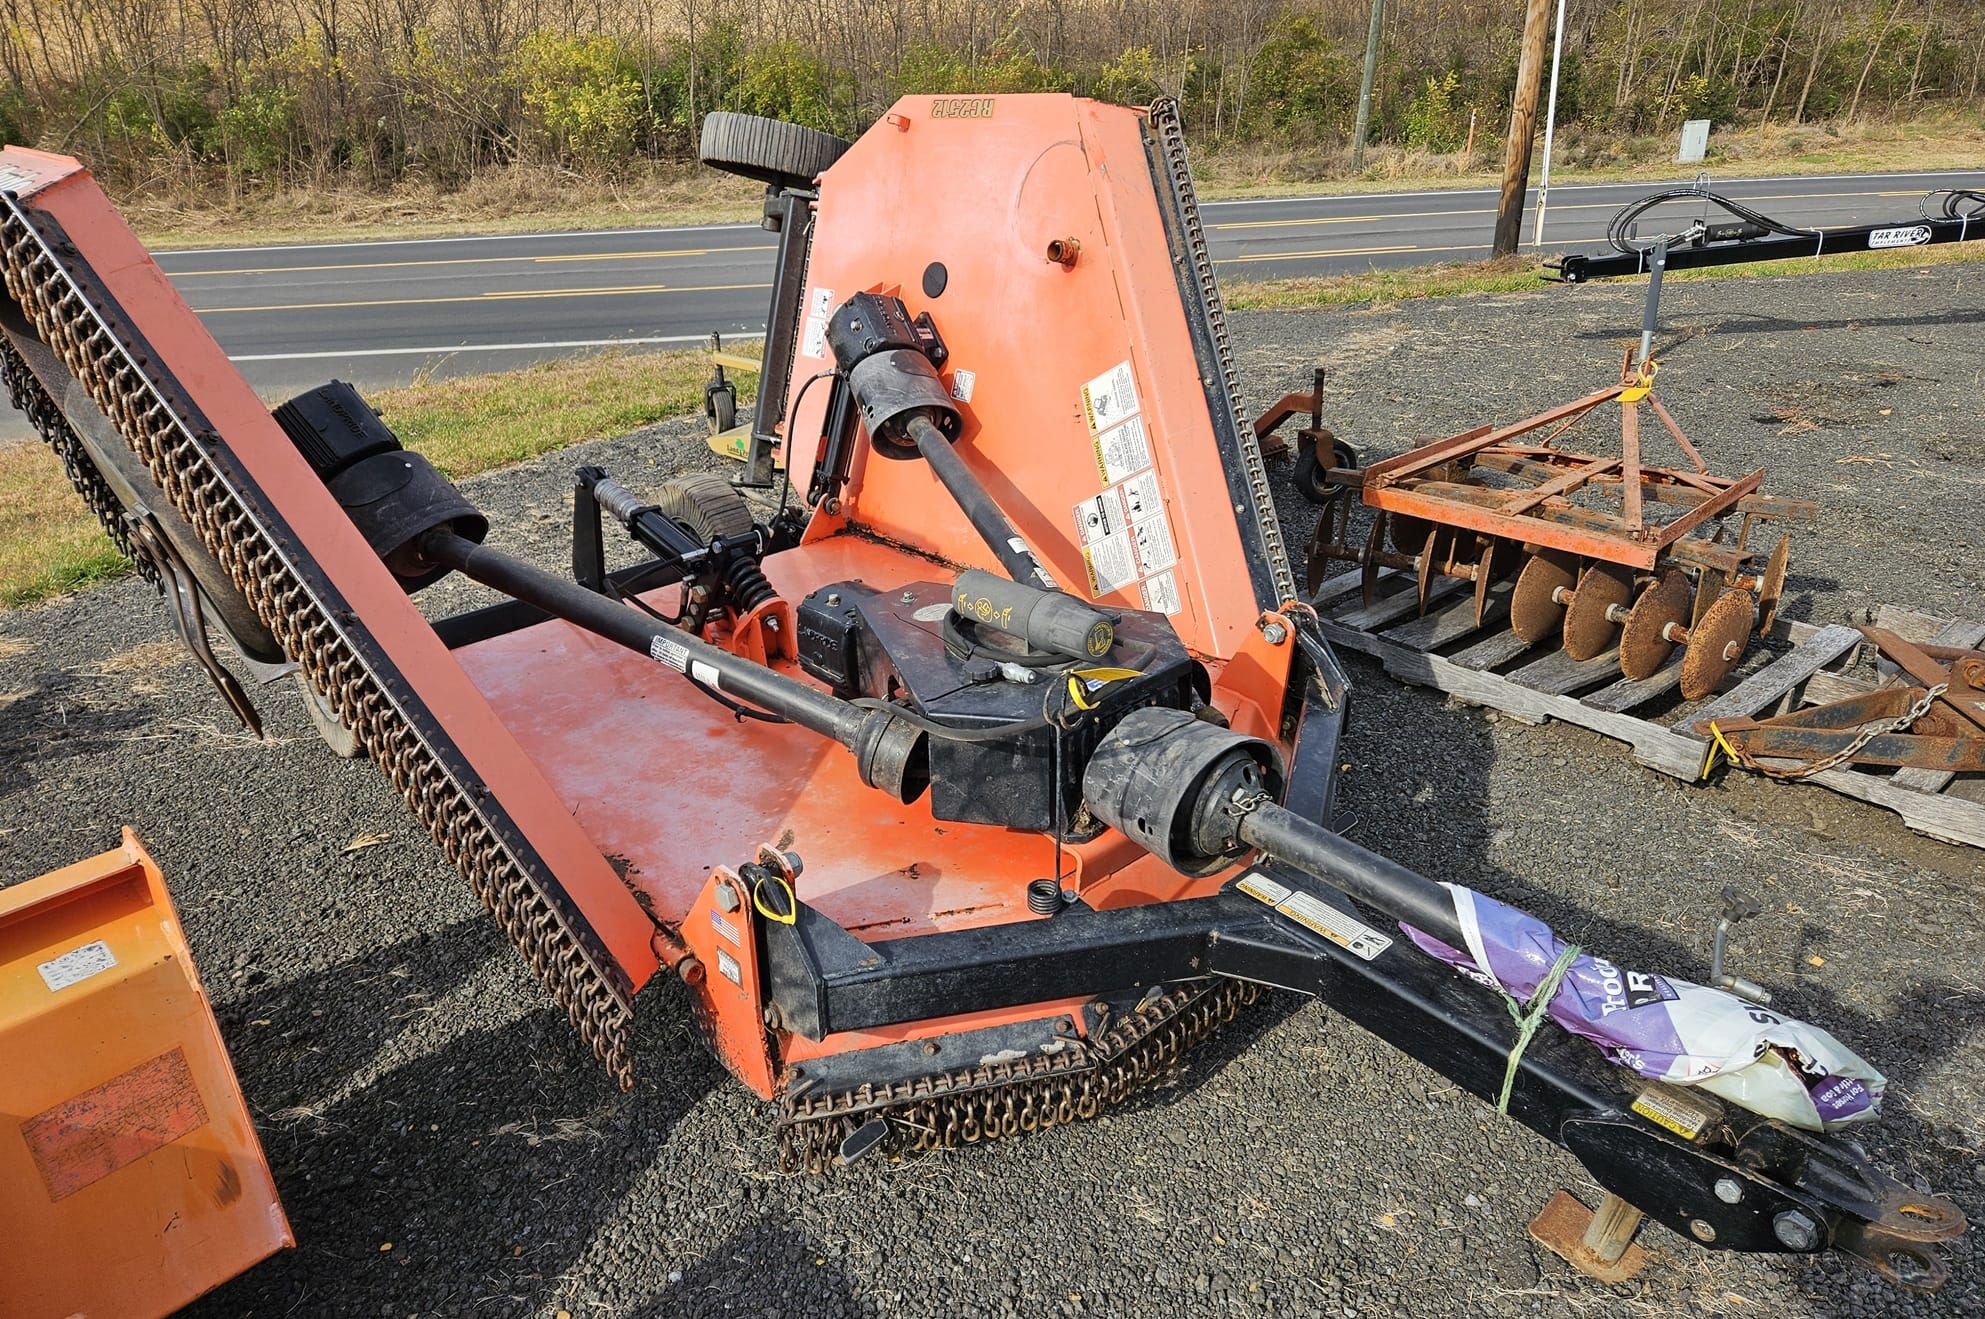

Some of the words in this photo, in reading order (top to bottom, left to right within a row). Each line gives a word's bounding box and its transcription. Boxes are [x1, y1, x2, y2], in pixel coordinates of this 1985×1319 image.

[932, 99, 995, 118] RC2512
[1873, 231, 1892, 240] TAR
[1893, 229, 1924, 239] RIVER
[1083, 387, 1095, 422] WARNING
[1092, 441, 1106, 478] WARNING
[1118, 488, 1128, 512] DANGER
[1073, 507, 1085, 535] DANGER
[1129, 535, 1141, 563] DANGER
[1084, 551, 1096, 582] WARNING
[1140, 585, 1151, 610] DANGER
[654, 636, 687, 654] IMPORTANT
[1239, 883, 1267, 900] WARNING
[1289, 909, 1327, 933] WARNING
[1849, 1084, 1864, 1097] For
[1634, 1104, 1676, 1129] CAUTION
